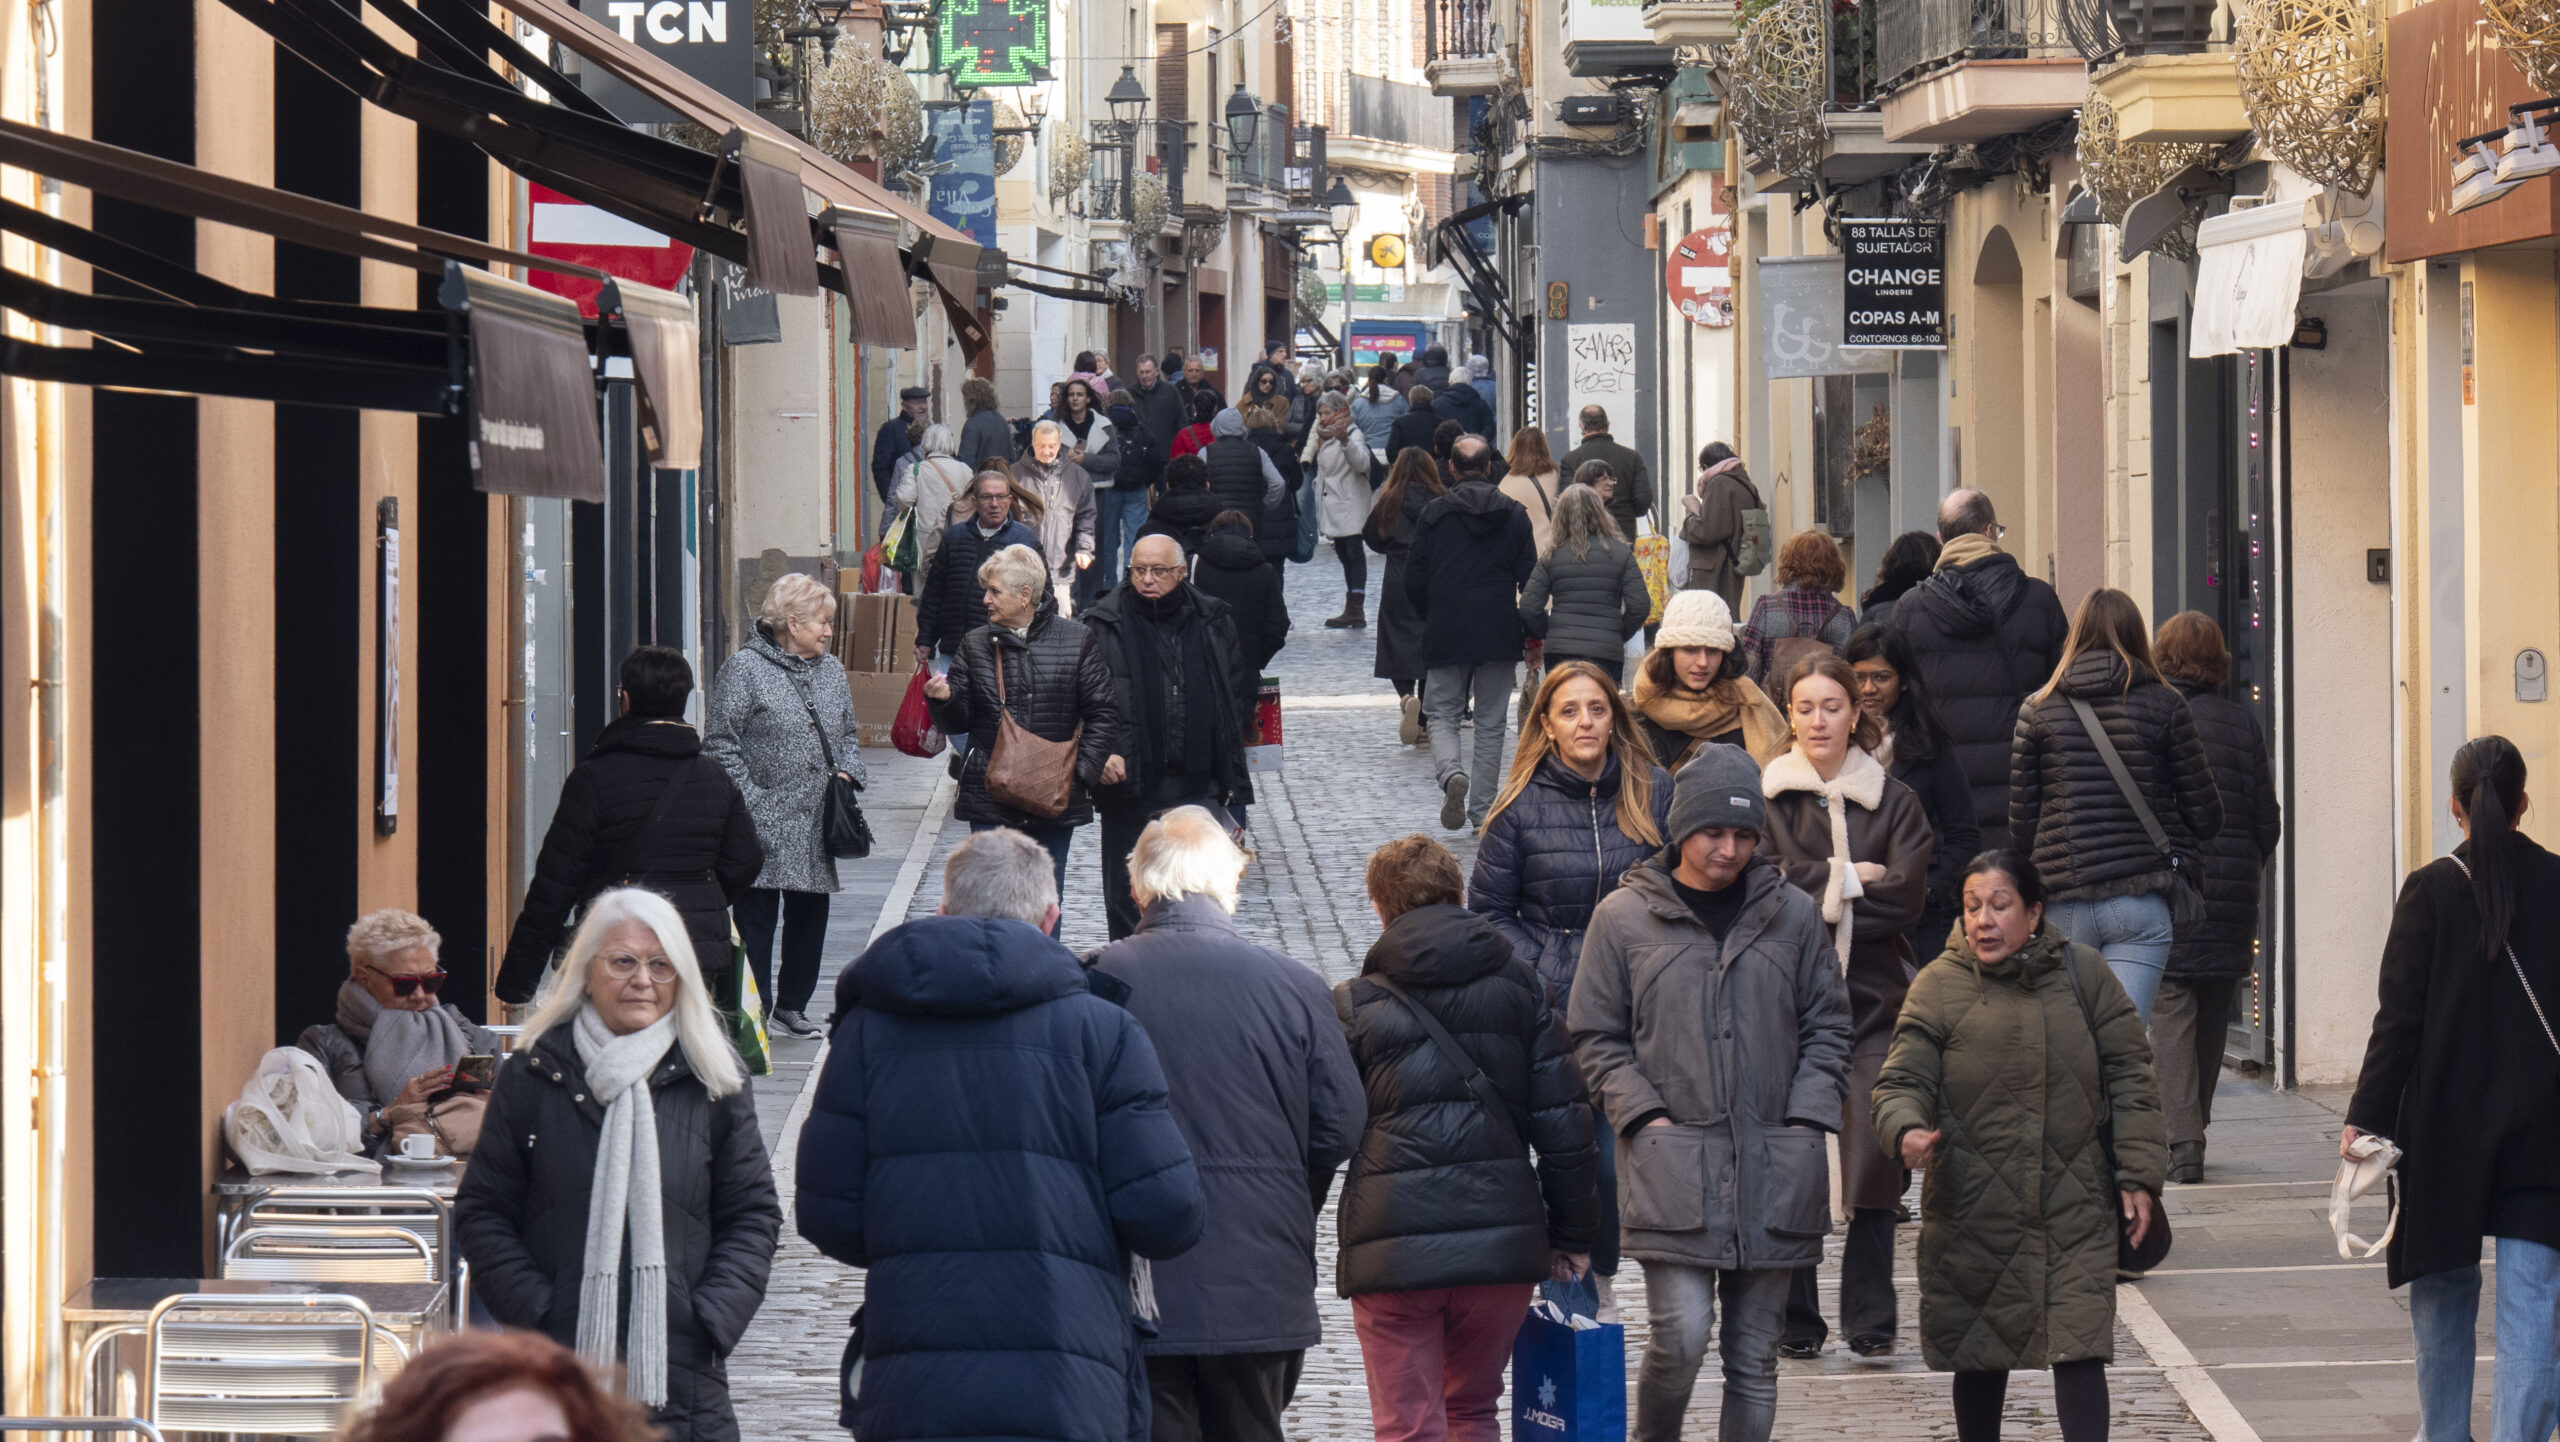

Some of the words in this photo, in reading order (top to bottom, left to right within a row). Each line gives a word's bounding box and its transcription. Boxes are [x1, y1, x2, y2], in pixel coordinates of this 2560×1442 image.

[609, 1, 727, 44] TCN
[1851, 226, 1867, 239] 88
[1870, 226, 1916, 239] TALLAS
[1919, 226, 1937, 239] DE
[1855, 242, 1933, 254] SUJETADOR
[1847, 268, 1941, 286] CHANGE
[1875, 288, 1914, 297] LINGERIE
[1849, 310, 1906, 326] COPAS
[1908, 311, 1941, 325] A-M
[1849, 334, 1909, 344] CONTORNOS
[1911, 334, 1941, 344] 60-100
[1522, 1407, 1565, 1432] J.MOGA
